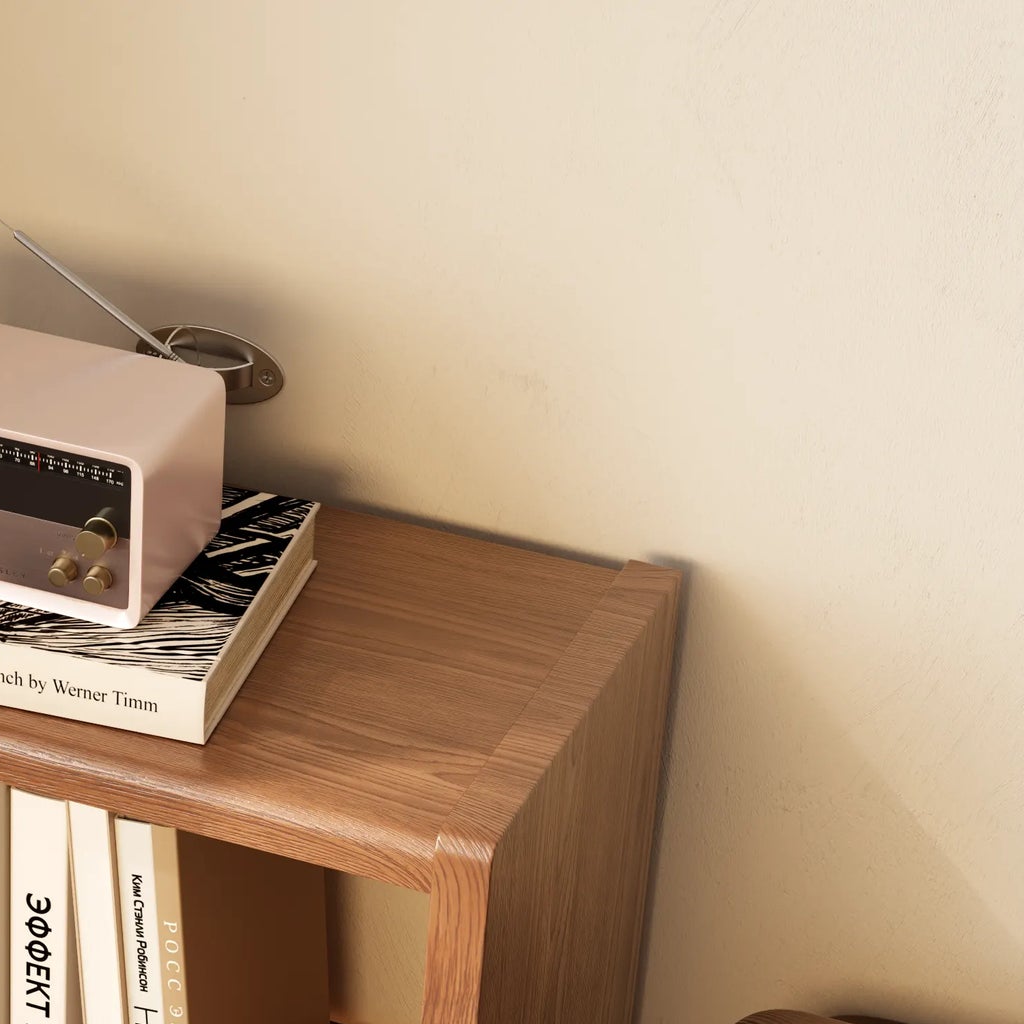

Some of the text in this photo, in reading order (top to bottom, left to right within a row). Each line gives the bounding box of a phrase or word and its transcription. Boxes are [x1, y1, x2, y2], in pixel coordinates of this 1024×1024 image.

[28, 673, 48, 695] by
[52, 678, 108, 703] Werner
[111, 689, 159, 713] Timm
[24, 892, 53, 1019] ЭФФЕКТ
[131, 873, 149, 993] Ким Стэнли Робинсон
[163, 921, 182, 992] РОСС
